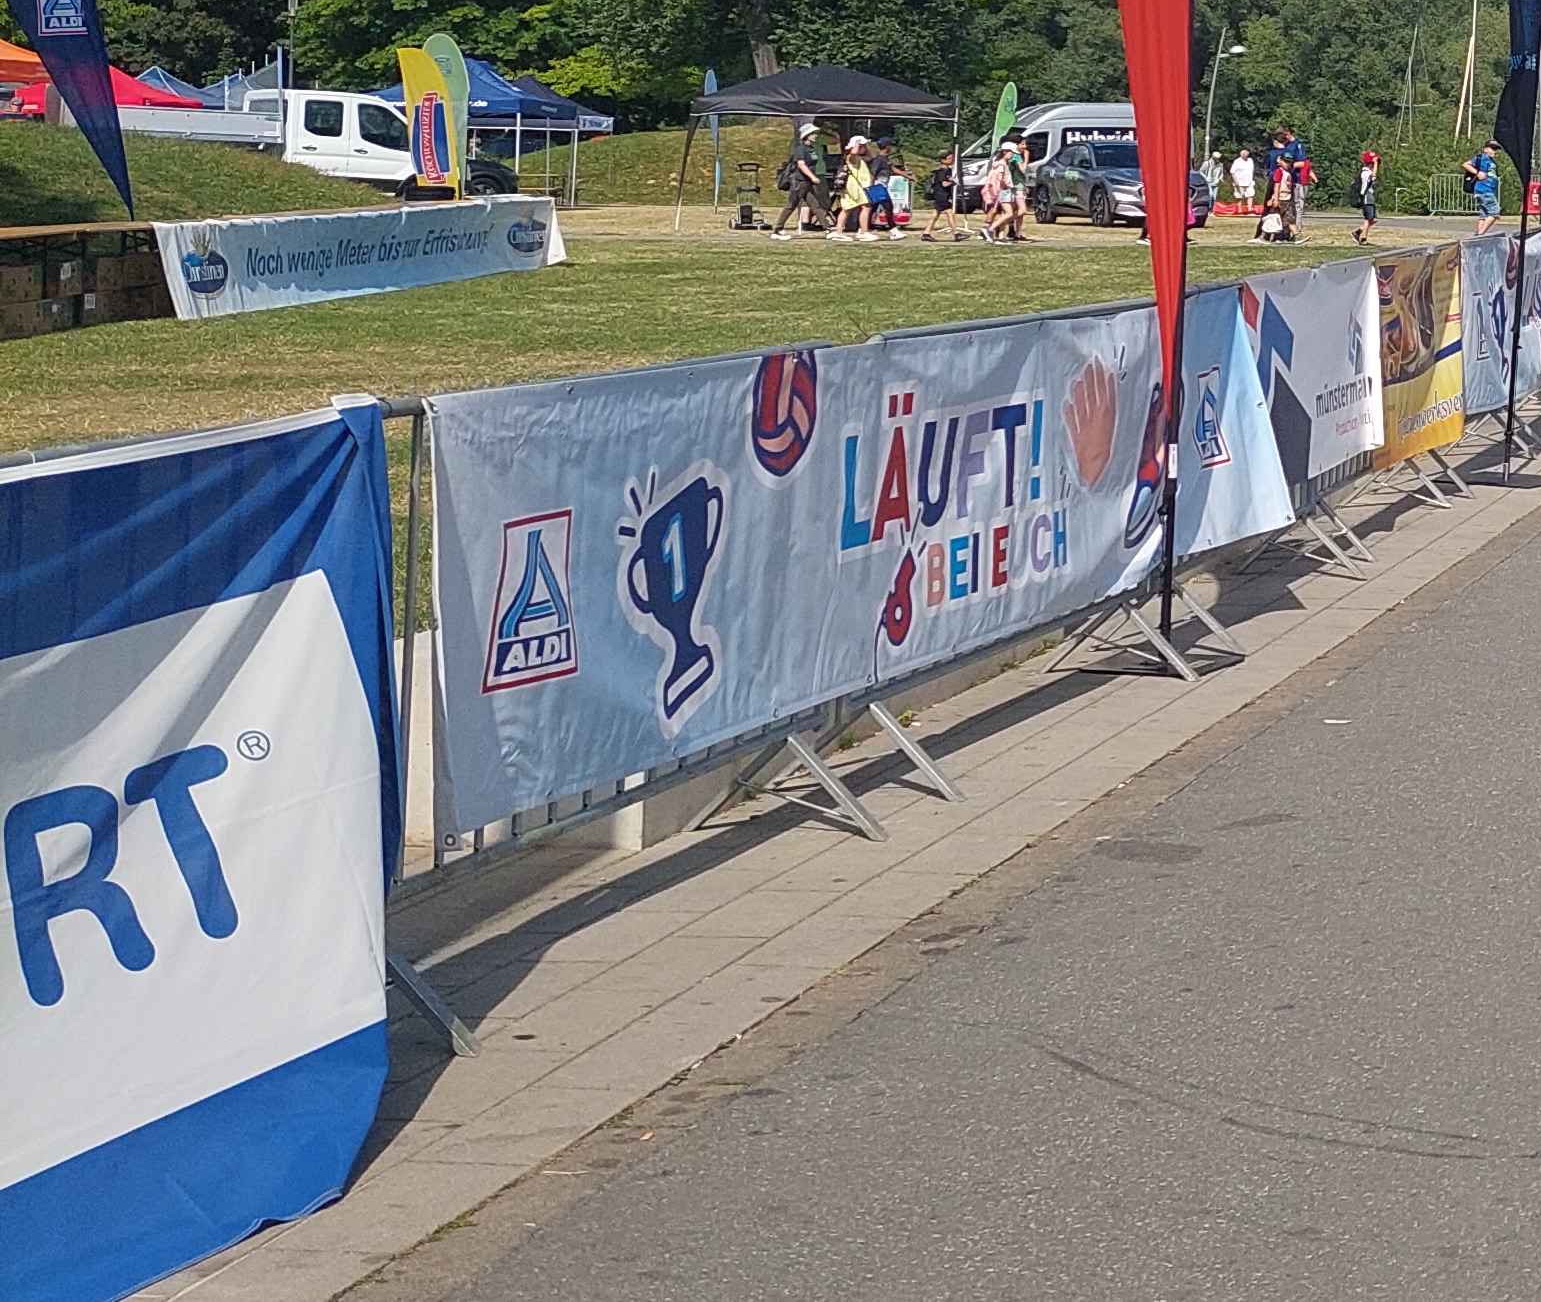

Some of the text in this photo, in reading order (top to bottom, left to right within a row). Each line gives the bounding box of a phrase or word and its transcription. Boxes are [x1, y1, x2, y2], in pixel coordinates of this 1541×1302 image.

[49, 16, 83, 28] ALDI
[247, 246, 284, 278] Noch
[336, 238, 376, 268] Meter
[378, 234, 401, 262] bis
[841, 392, 1044, 551] LÄUFT!
[926, 509, 1068, 608] BEI EUCH
[502, 629, 570, 673] ALDI
